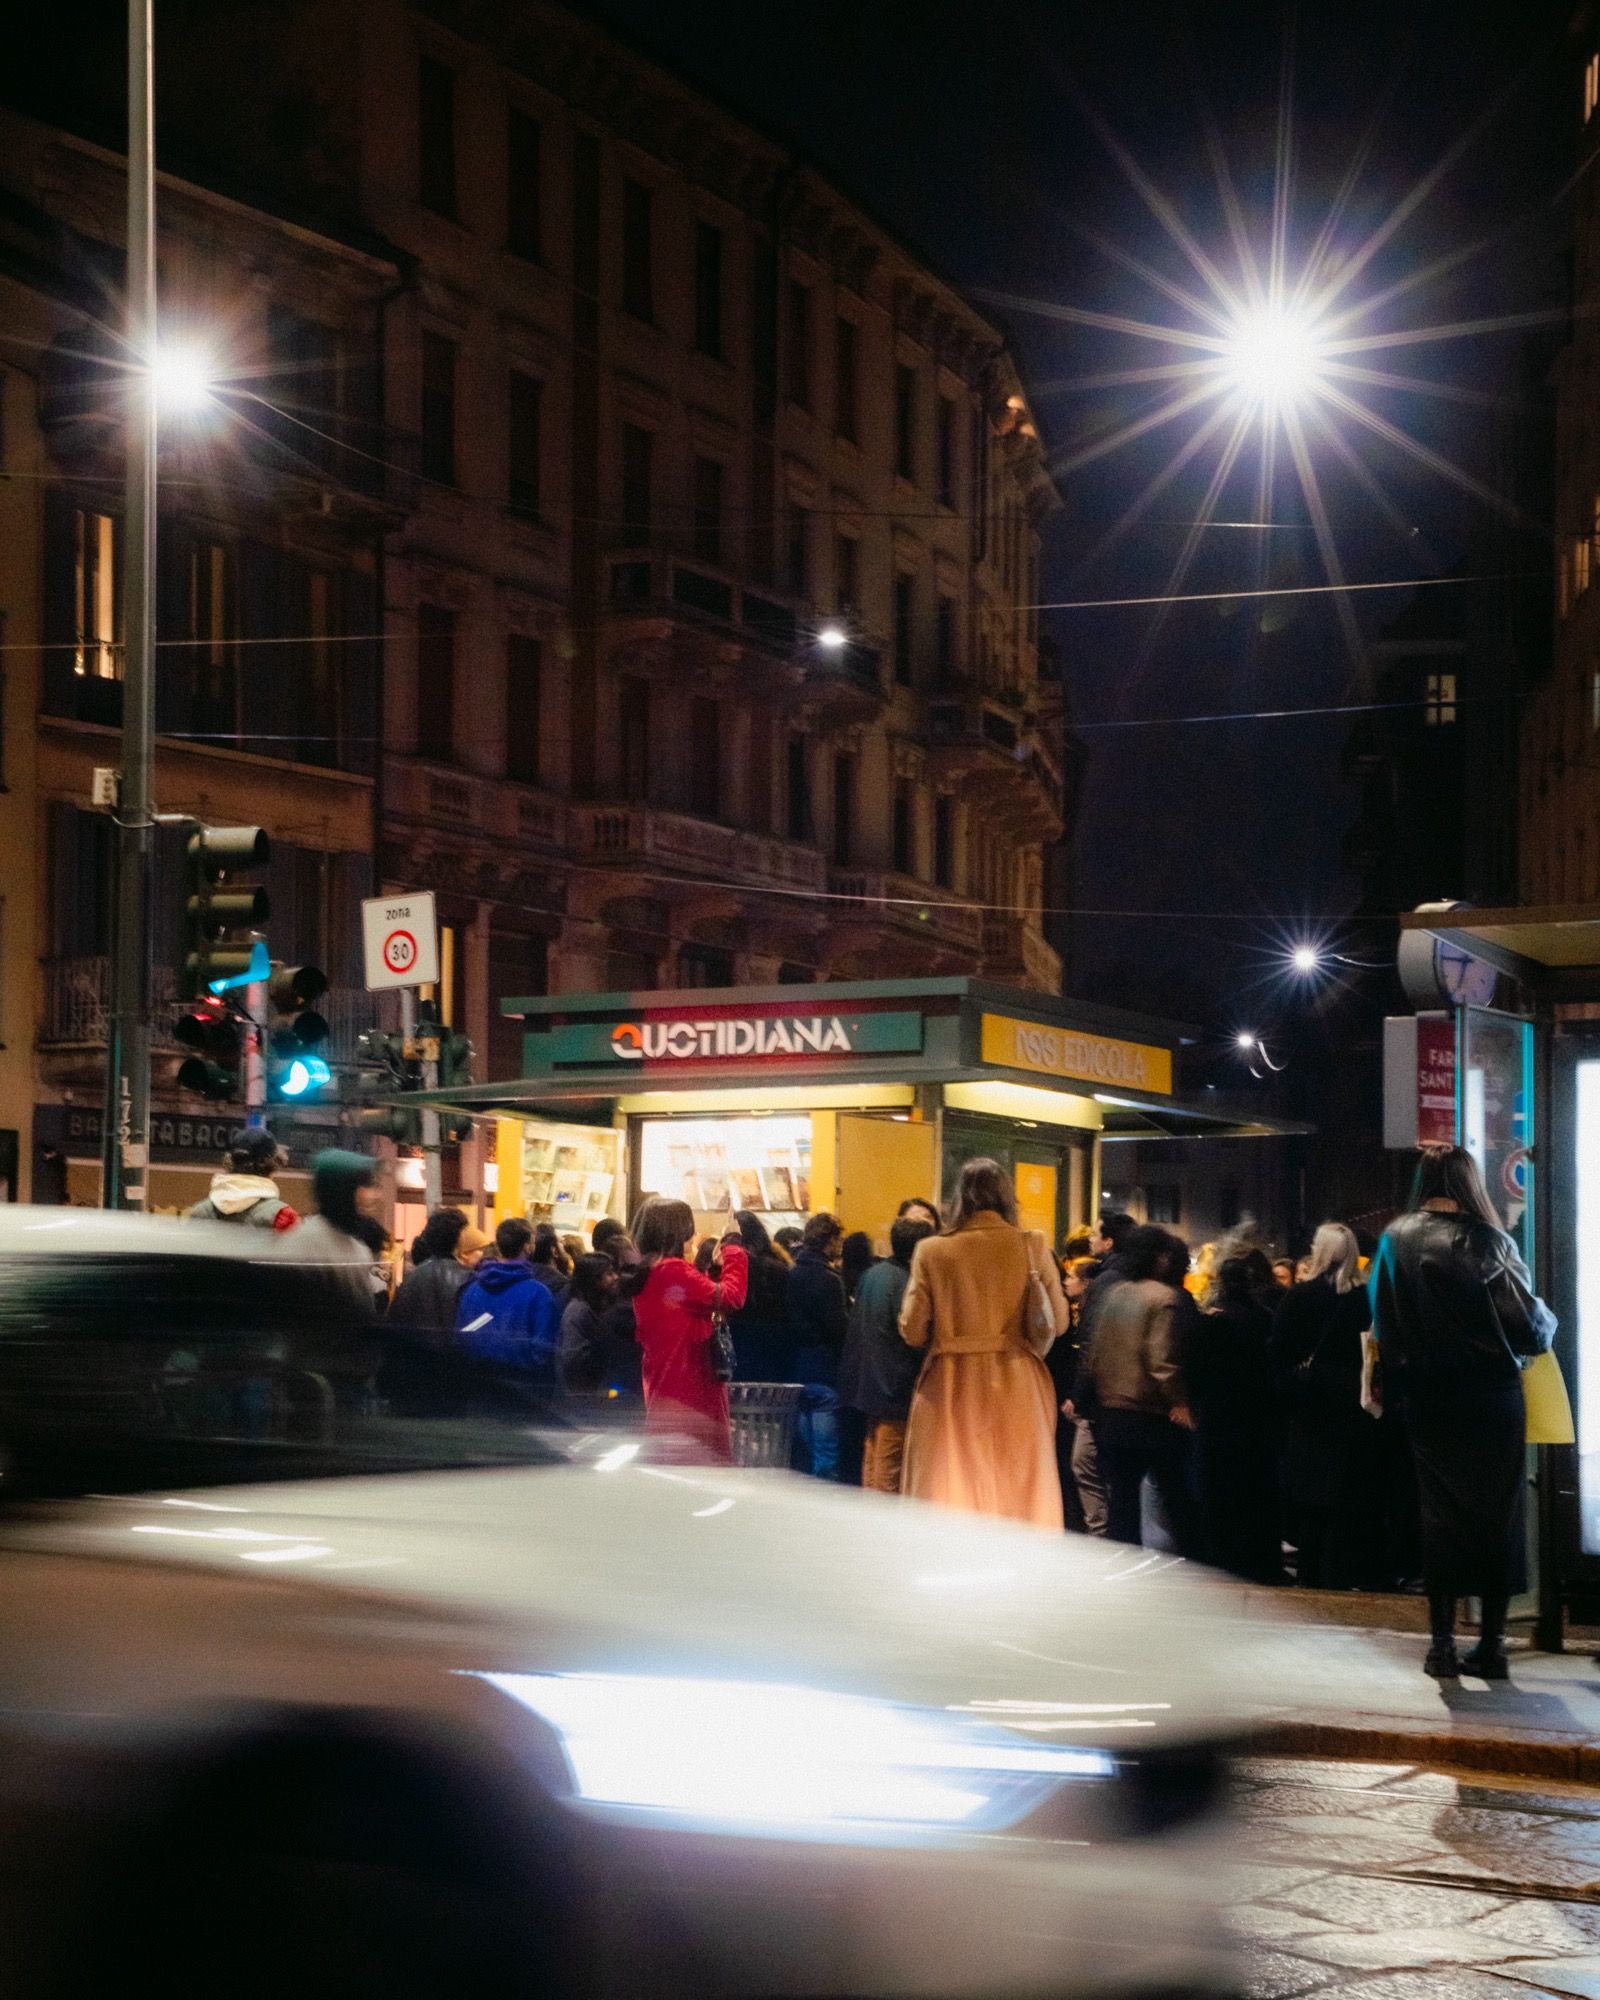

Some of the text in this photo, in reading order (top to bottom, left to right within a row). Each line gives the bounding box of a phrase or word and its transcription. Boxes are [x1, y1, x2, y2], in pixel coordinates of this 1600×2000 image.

[385, 907, 411, 920] zona
[392, 943, 410, 961] 30
[610, 1016, 853, 1059] QUOTIDIANA
[1063, 1037, 1147, 1085] EDICOLA
[1429, 1048, 1455, 1067] FAR
[1418, 1071, 1455, 1089] SANT
[69, 1112, 100, 1137] BA
